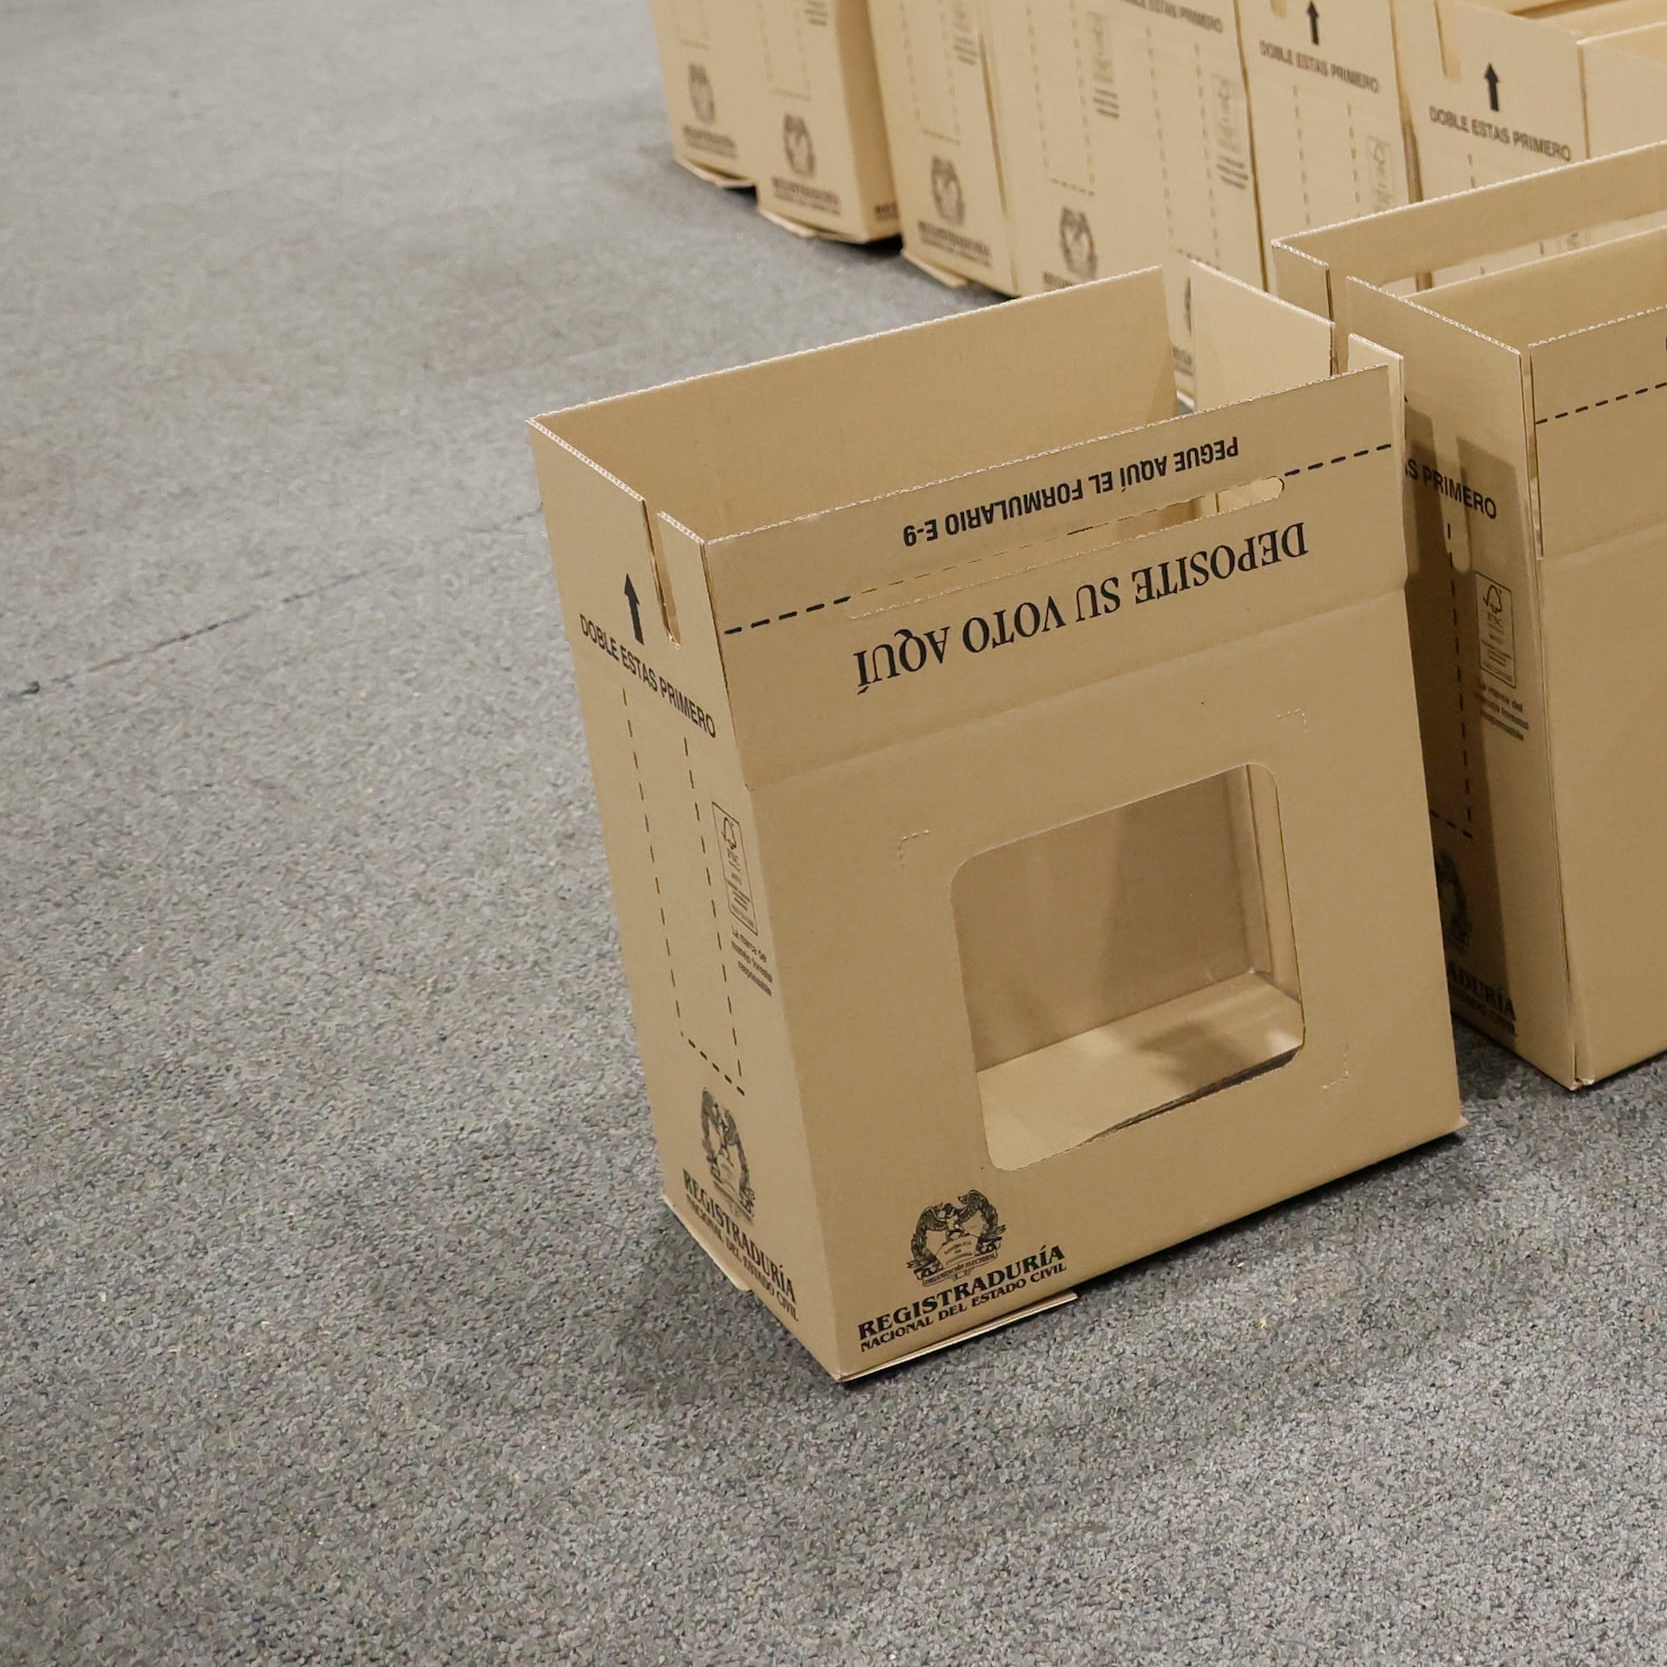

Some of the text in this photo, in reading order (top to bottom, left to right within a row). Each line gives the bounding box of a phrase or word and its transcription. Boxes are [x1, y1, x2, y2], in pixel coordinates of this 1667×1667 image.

[1259, 39, 1380, 94] DOBLE ESTAS PRIMERO
[1429, 106, 1571, 162] DOBLE ESTAS PRIMERO
[903, 436, 1239, 547] PEGUE AQUÍ EL FORMULARIO E-9
[1422, 465, 1497, 519] PRIMERO
[852, 522, 1309, 696] DEPOSITE SU VOTO AQUÍ
[579, 613, 716, 739] DOBLE ESTAS PRIMERO
[683, 1169, 796, 1305] REGISTRADURÍA
[857, 1245, 1065, 1340] REGISTRADURÍA
[860, 1264, 1067, 1353] NACIONAL DEL ESTADO CIVIL
